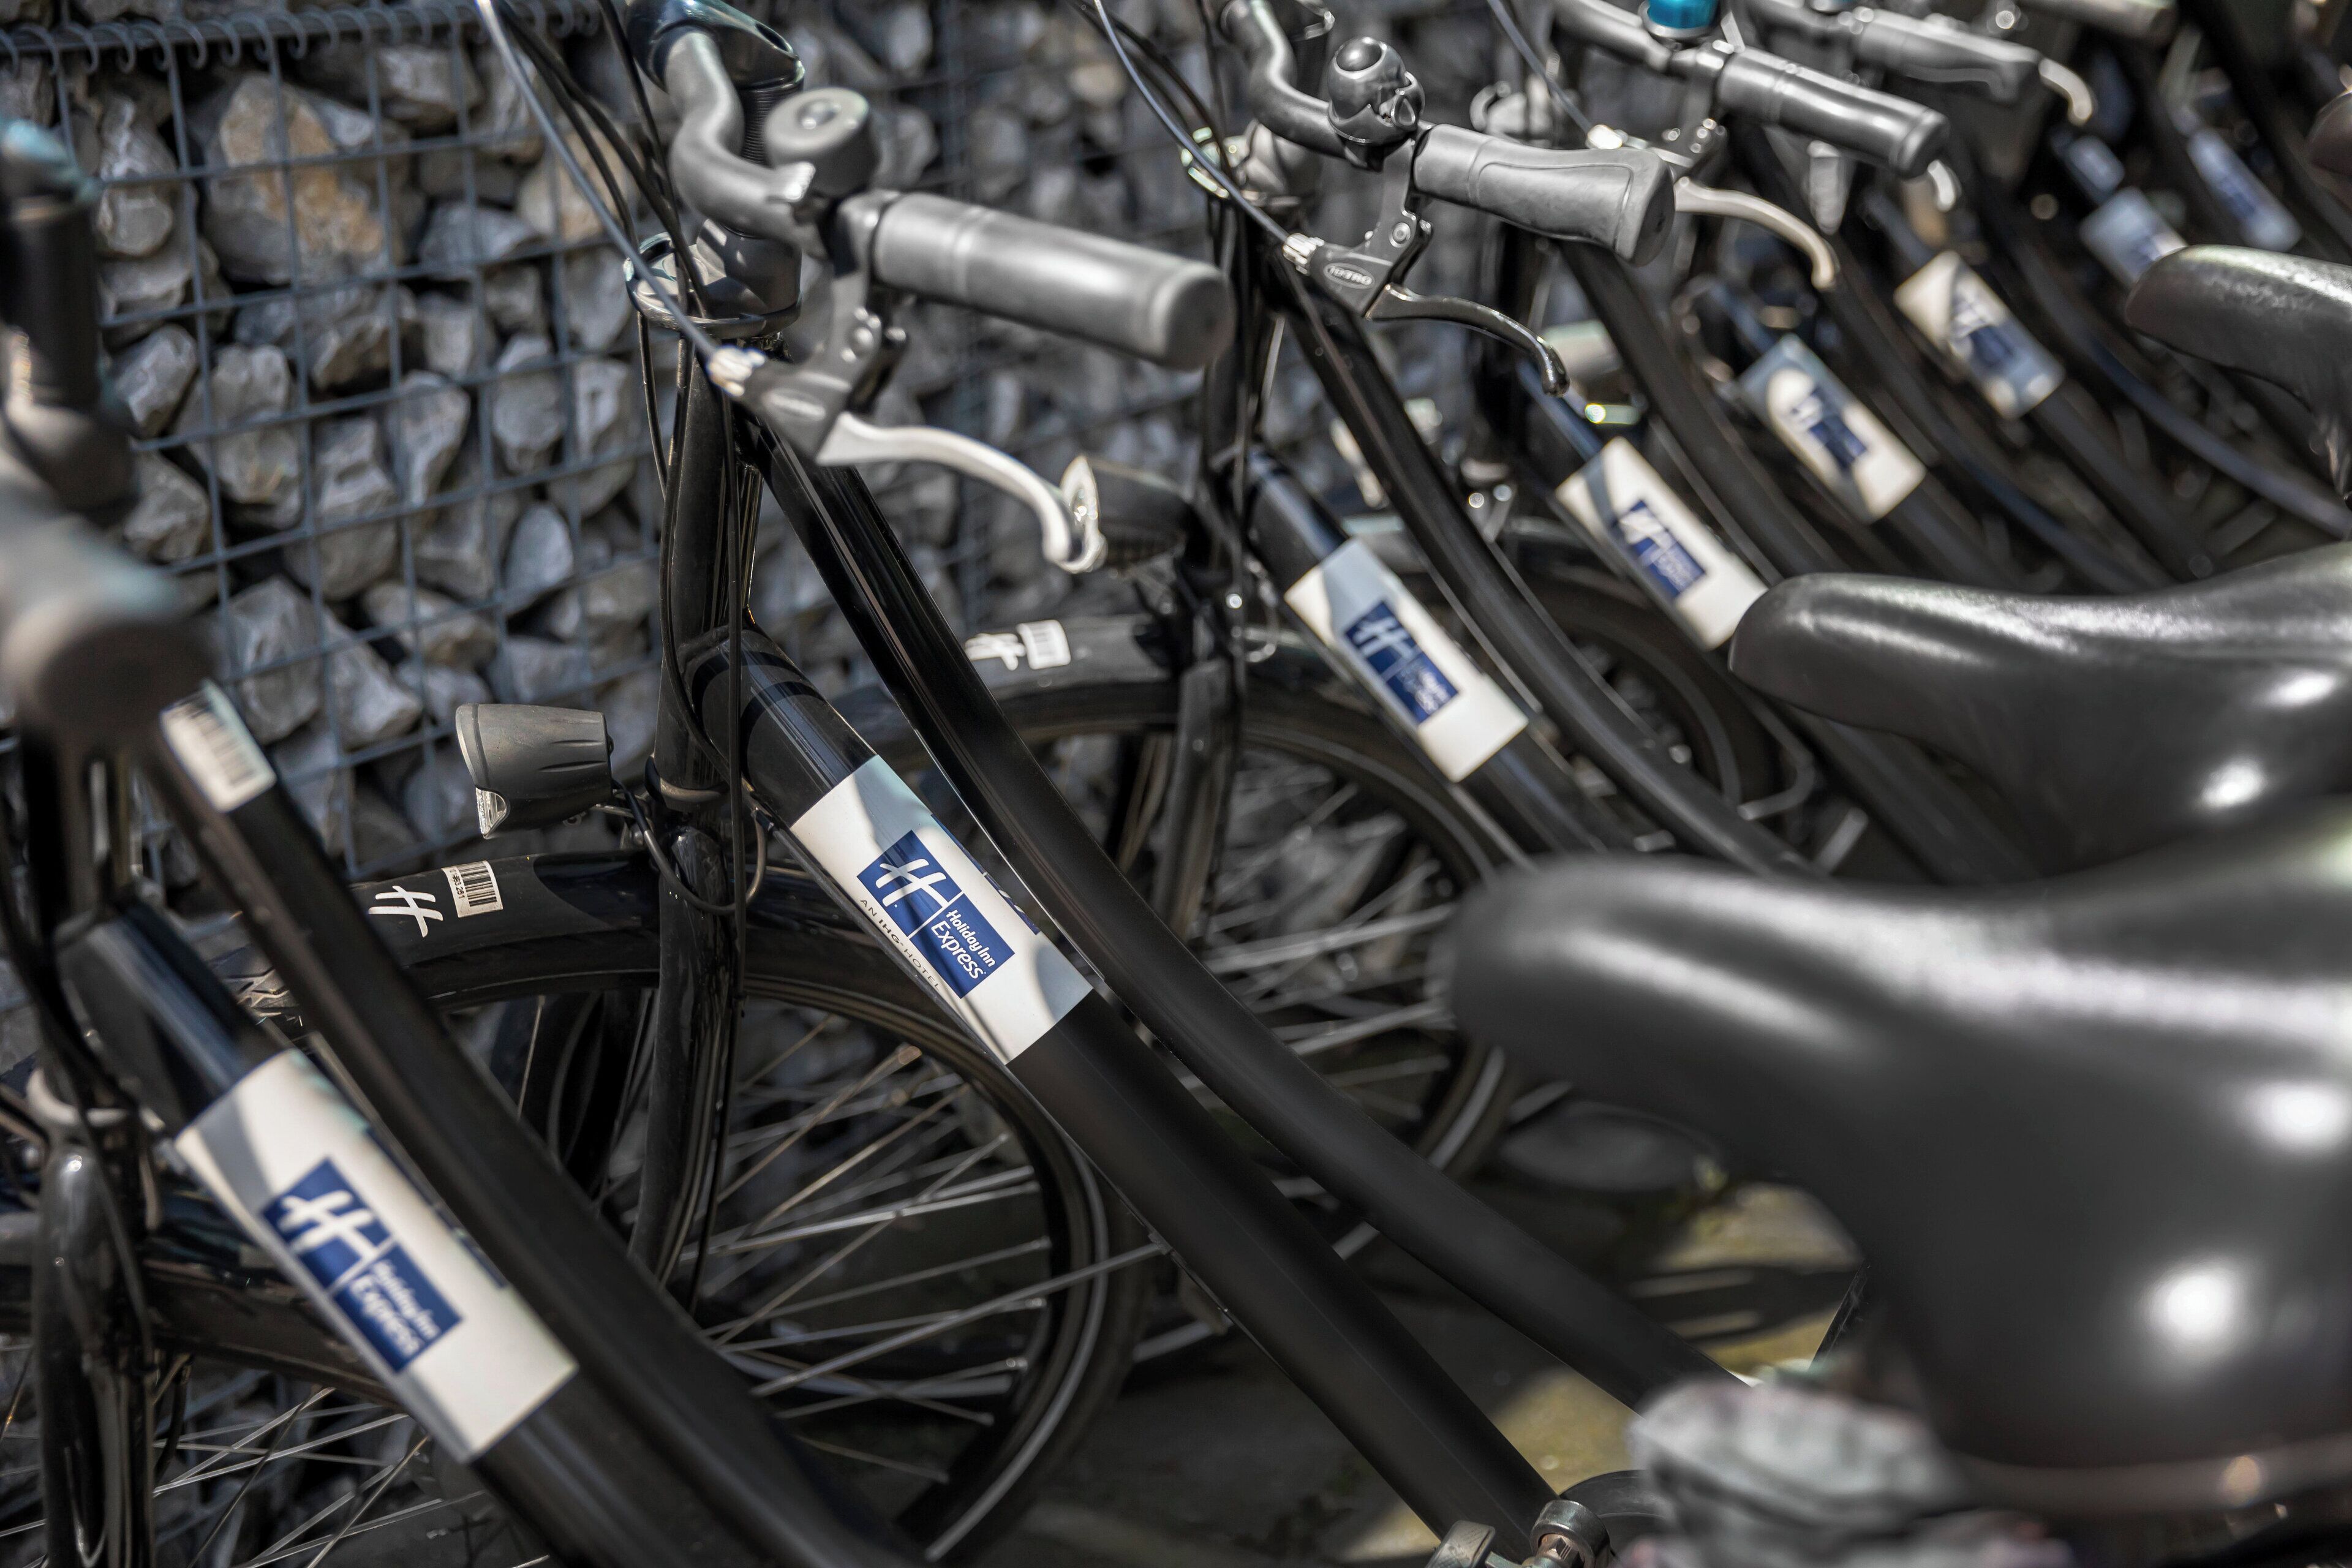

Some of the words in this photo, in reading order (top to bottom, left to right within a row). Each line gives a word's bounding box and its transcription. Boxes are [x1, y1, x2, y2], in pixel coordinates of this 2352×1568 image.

[860, 900, 877, 917] AN
[903, 948, 942, 991] HOTEL
[930, 920, 984, 979] Express
[946, 909, 982, 951] Holiday
[977, 947, 996, 967] Inn
